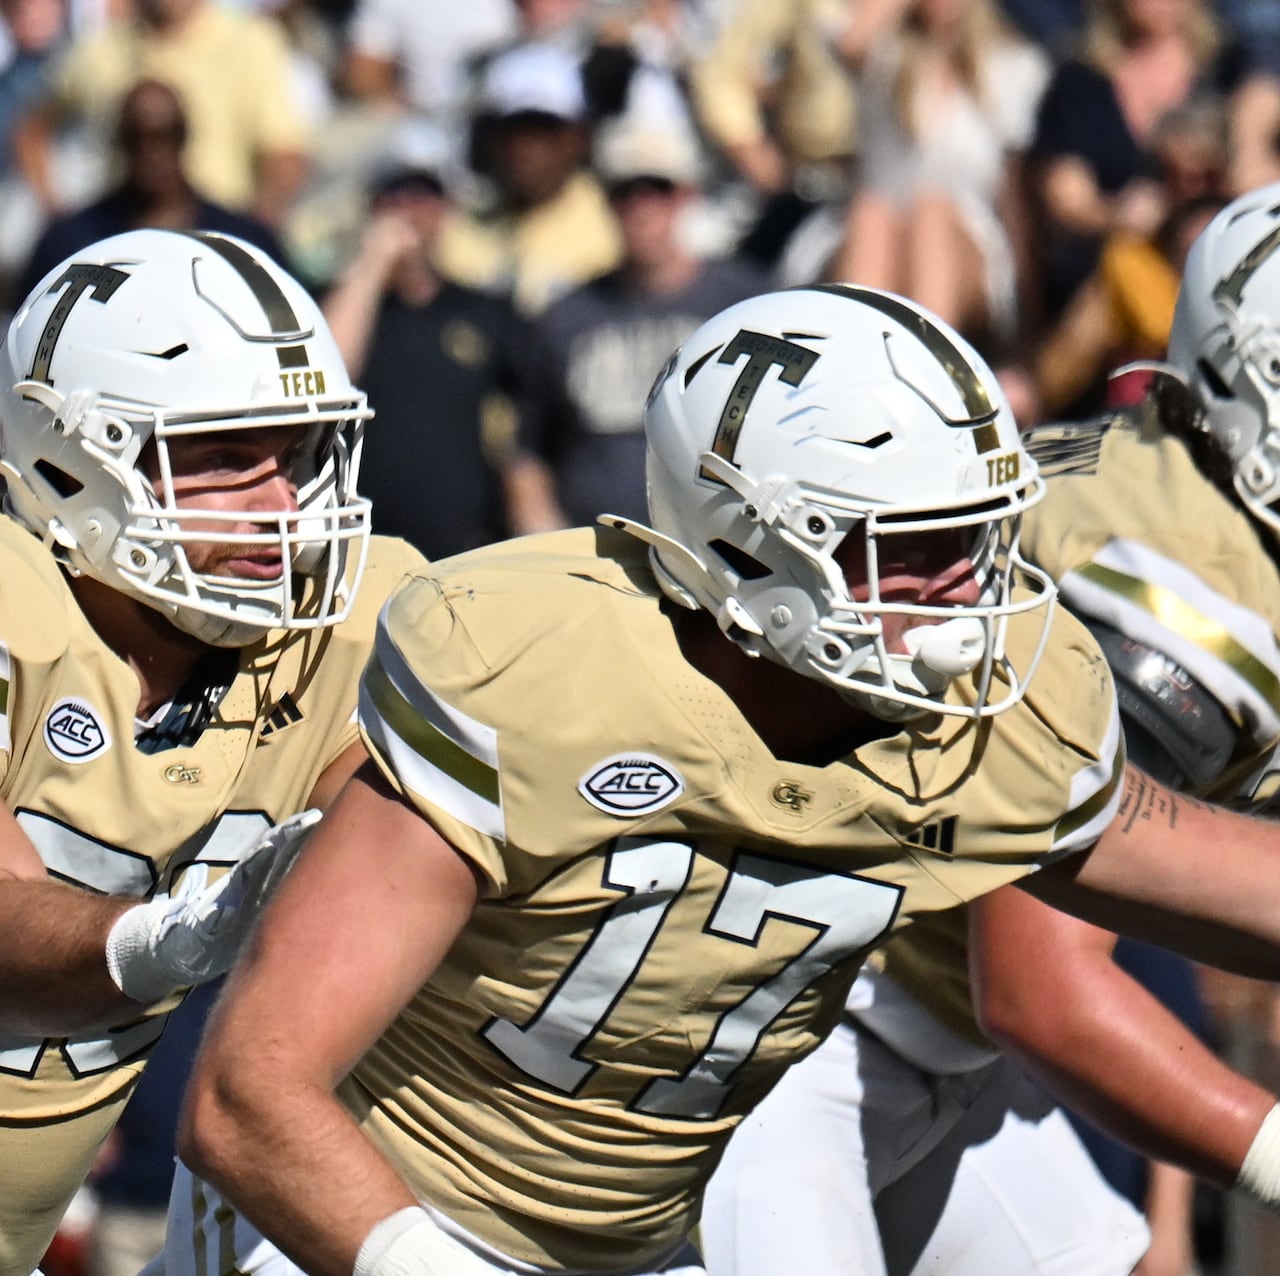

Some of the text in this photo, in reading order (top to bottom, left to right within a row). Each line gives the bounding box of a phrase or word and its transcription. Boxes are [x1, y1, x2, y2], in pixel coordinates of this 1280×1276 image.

[39, 287, 78, 361] TECH
[279, 371, 326, 398] TECH
[721, 365, 761, 443] TECH
[53, 714, 99, 742] ACC
[598, 771, 664, 791] ACC
[772, 779, 817, 812] GT
[476, 835, 907, 1121] 17
